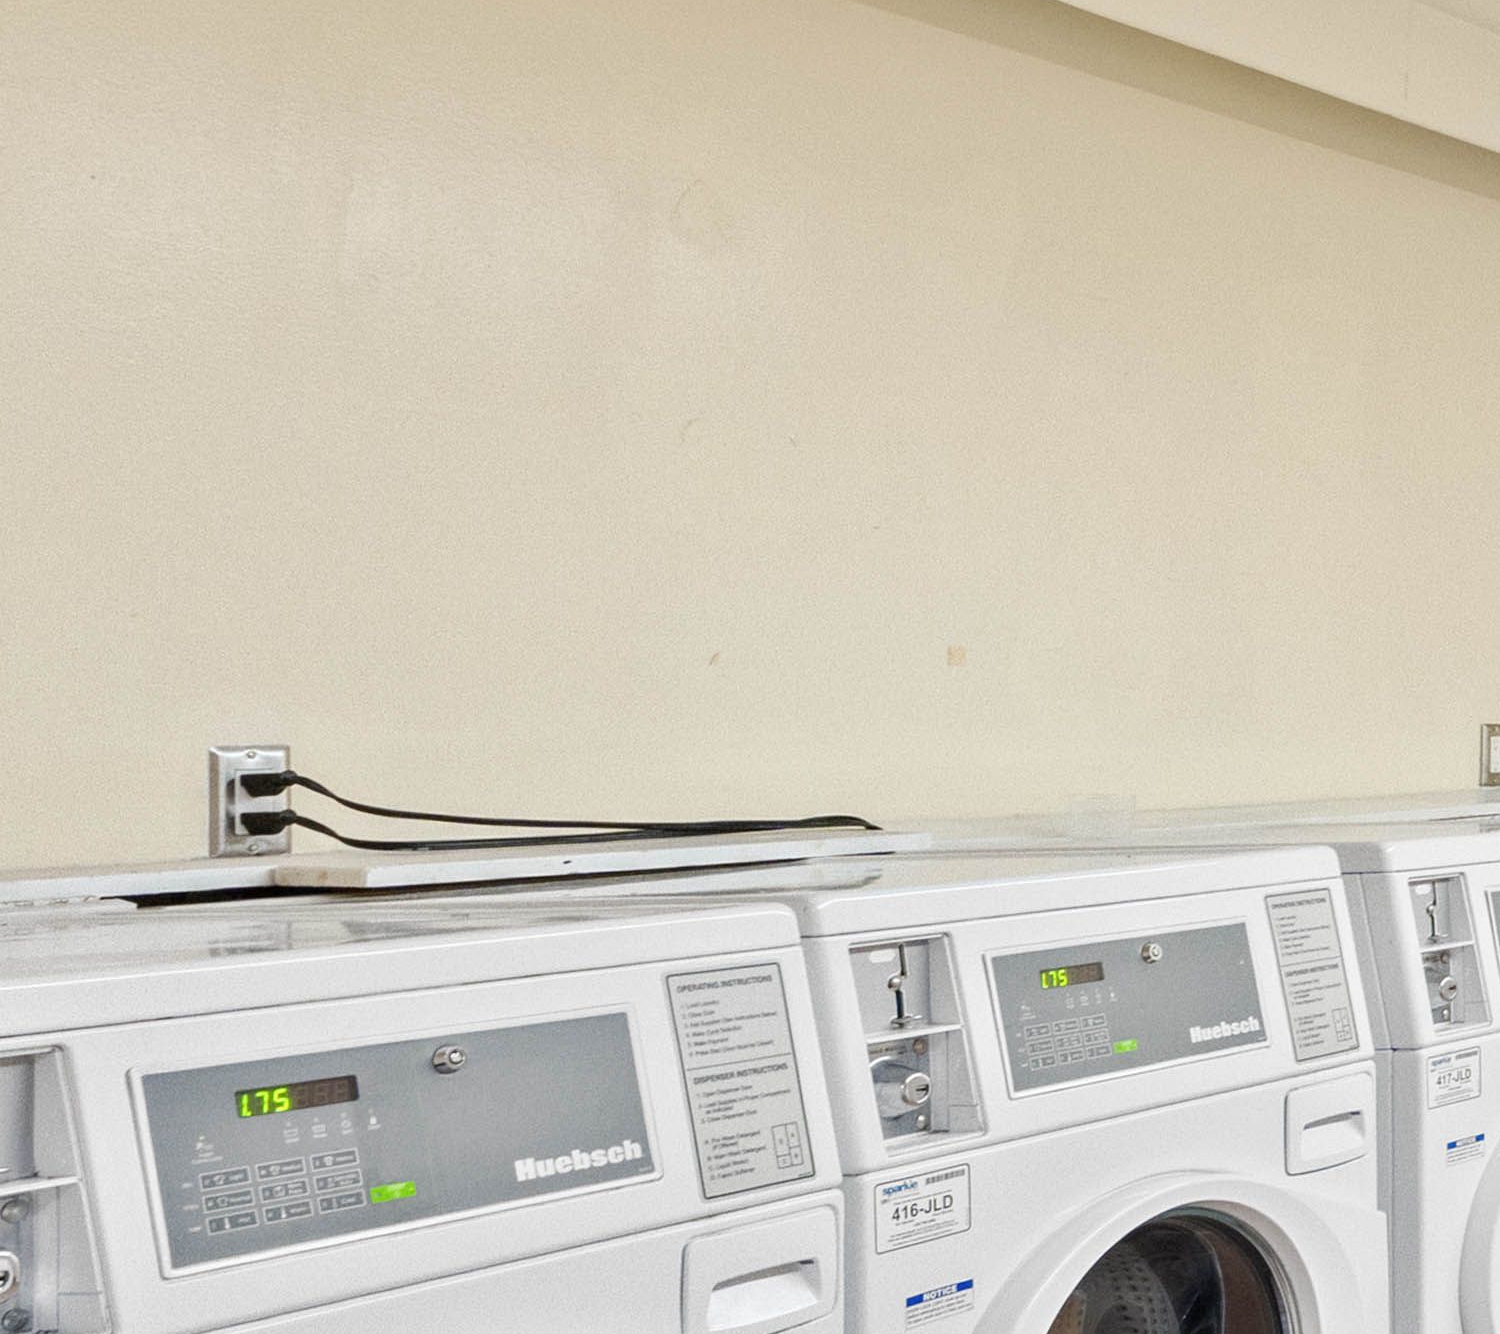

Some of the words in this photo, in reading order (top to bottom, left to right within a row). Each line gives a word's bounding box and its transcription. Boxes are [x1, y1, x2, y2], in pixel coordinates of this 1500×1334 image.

[1190, 1016, 1261, 1044] Huebsch
[514, 1139, 643, 1182] Huebsch
[891, 1194, 954, 1221] 416-JLD
[923, 1283, 957, 1302] NOTICE
